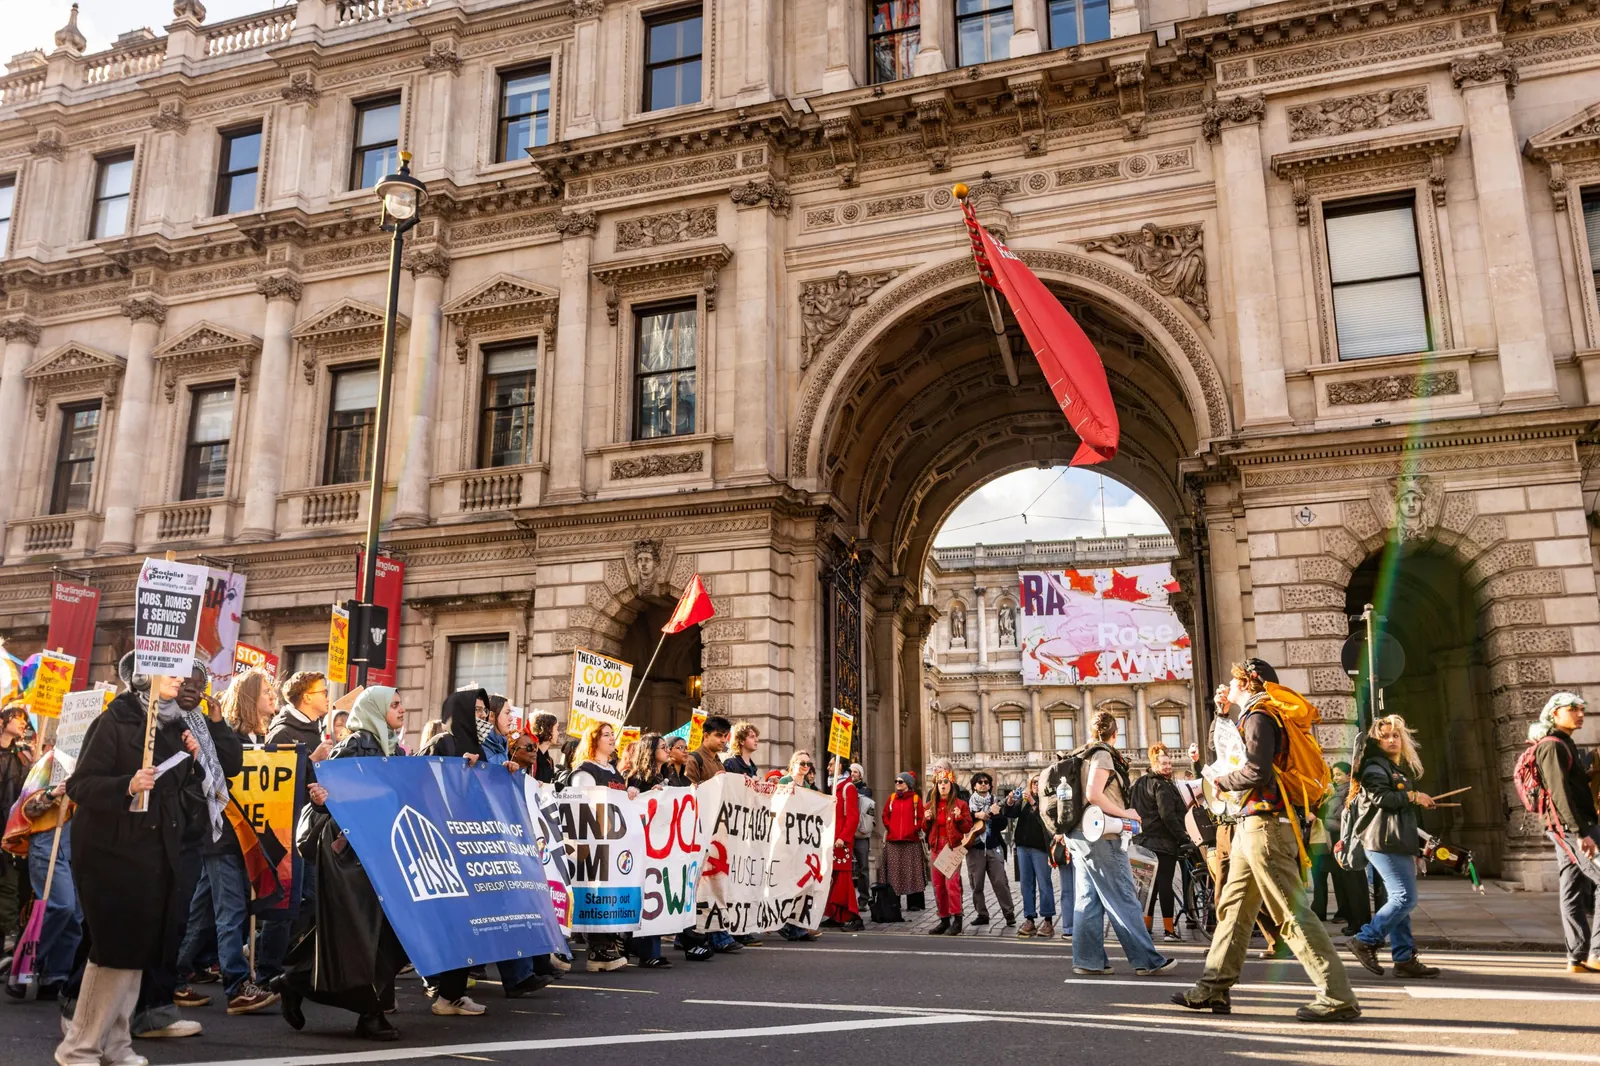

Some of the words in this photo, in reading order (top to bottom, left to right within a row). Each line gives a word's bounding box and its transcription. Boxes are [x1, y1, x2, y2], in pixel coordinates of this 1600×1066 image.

[152, 567, 184, 578] Socialist
[55, 591, 80, 603] House
[56, 583, 96, 599] Burlington
[1023, 574, 1066, 616] RA
[139, 591, 162, 608] JOBS,
[164, 594, 193, 610] HOMES
[142, 608, 149, 620] &
[150, 608, 187, 625] SERVICES
[146, 622, 164, 637] FOR
[163, 624, 179, 638] ALL!
[1098, 622, 1174, 649] Rose
[136, 639, 160, 652] MASH
[161, 641, 191, 655] RACISM
[236, 645, 267, 665] STOP
[583, 665, 623, 689] GOOD
[577, 683, 584, 693] in
[586, 685, 599, 697] this
[64, 701, 73, 713] NO
[76, 697, 101, 708] RACISM
[575, 698, 588, 709] and
[589, 701, 601, 712] it's
[446, 820, 512, 836] FEDERATION
[509, 824, 524, 837] OF
[456, 840, 508, 855] STUDENT
[506, 841, 539, 858] ISLAMIC
[466, 861, 523, 877] SOCIETIES
[473, 881, 505, 893] DEVELOP
[508, 880, 534, 890] EMPOWER
[585, 893, 617, 907] Stamp
[620, 894, 630, 904] out
[578, 907, 636, 920] antisemitism
